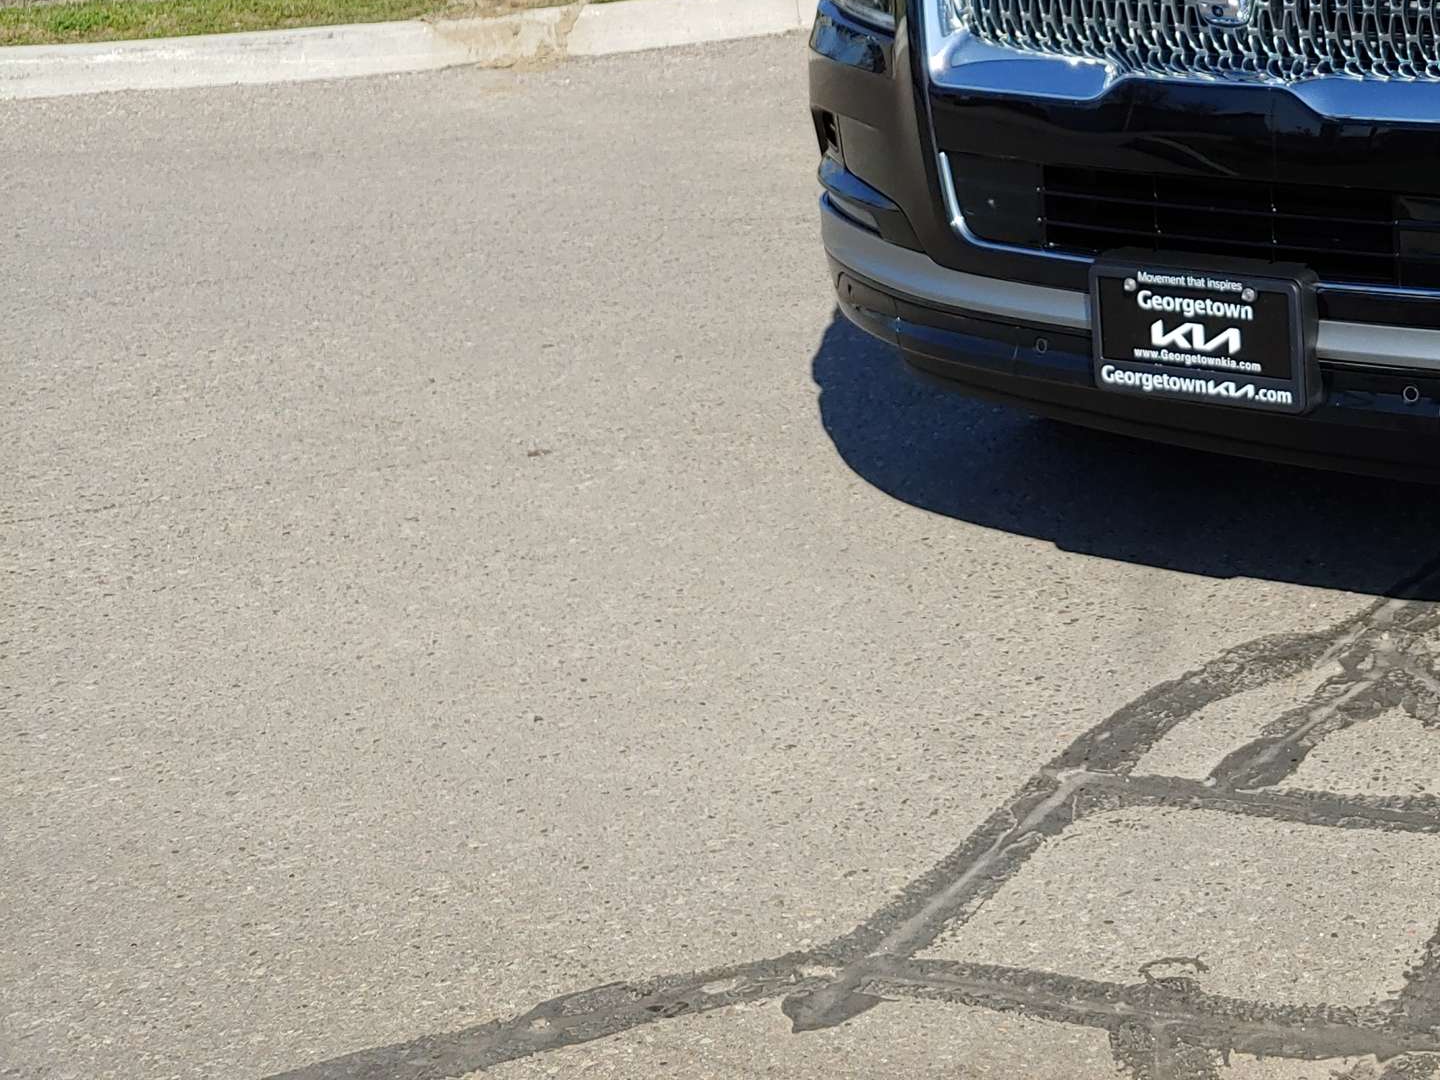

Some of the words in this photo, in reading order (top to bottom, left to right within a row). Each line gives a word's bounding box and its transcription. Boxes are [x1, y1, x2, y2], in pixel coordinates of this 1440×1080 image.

[1137, 270, 1185, 286] Movement
[1186, 273, 1206, 289] that
[1206, 275, 1243, 292] inspires
[1137, 290, 1253, 320] Georgetown
[1150, 319, 1242, 355] KIA
[1133, 347, 1262, 373] www.Georgetownkia.com
